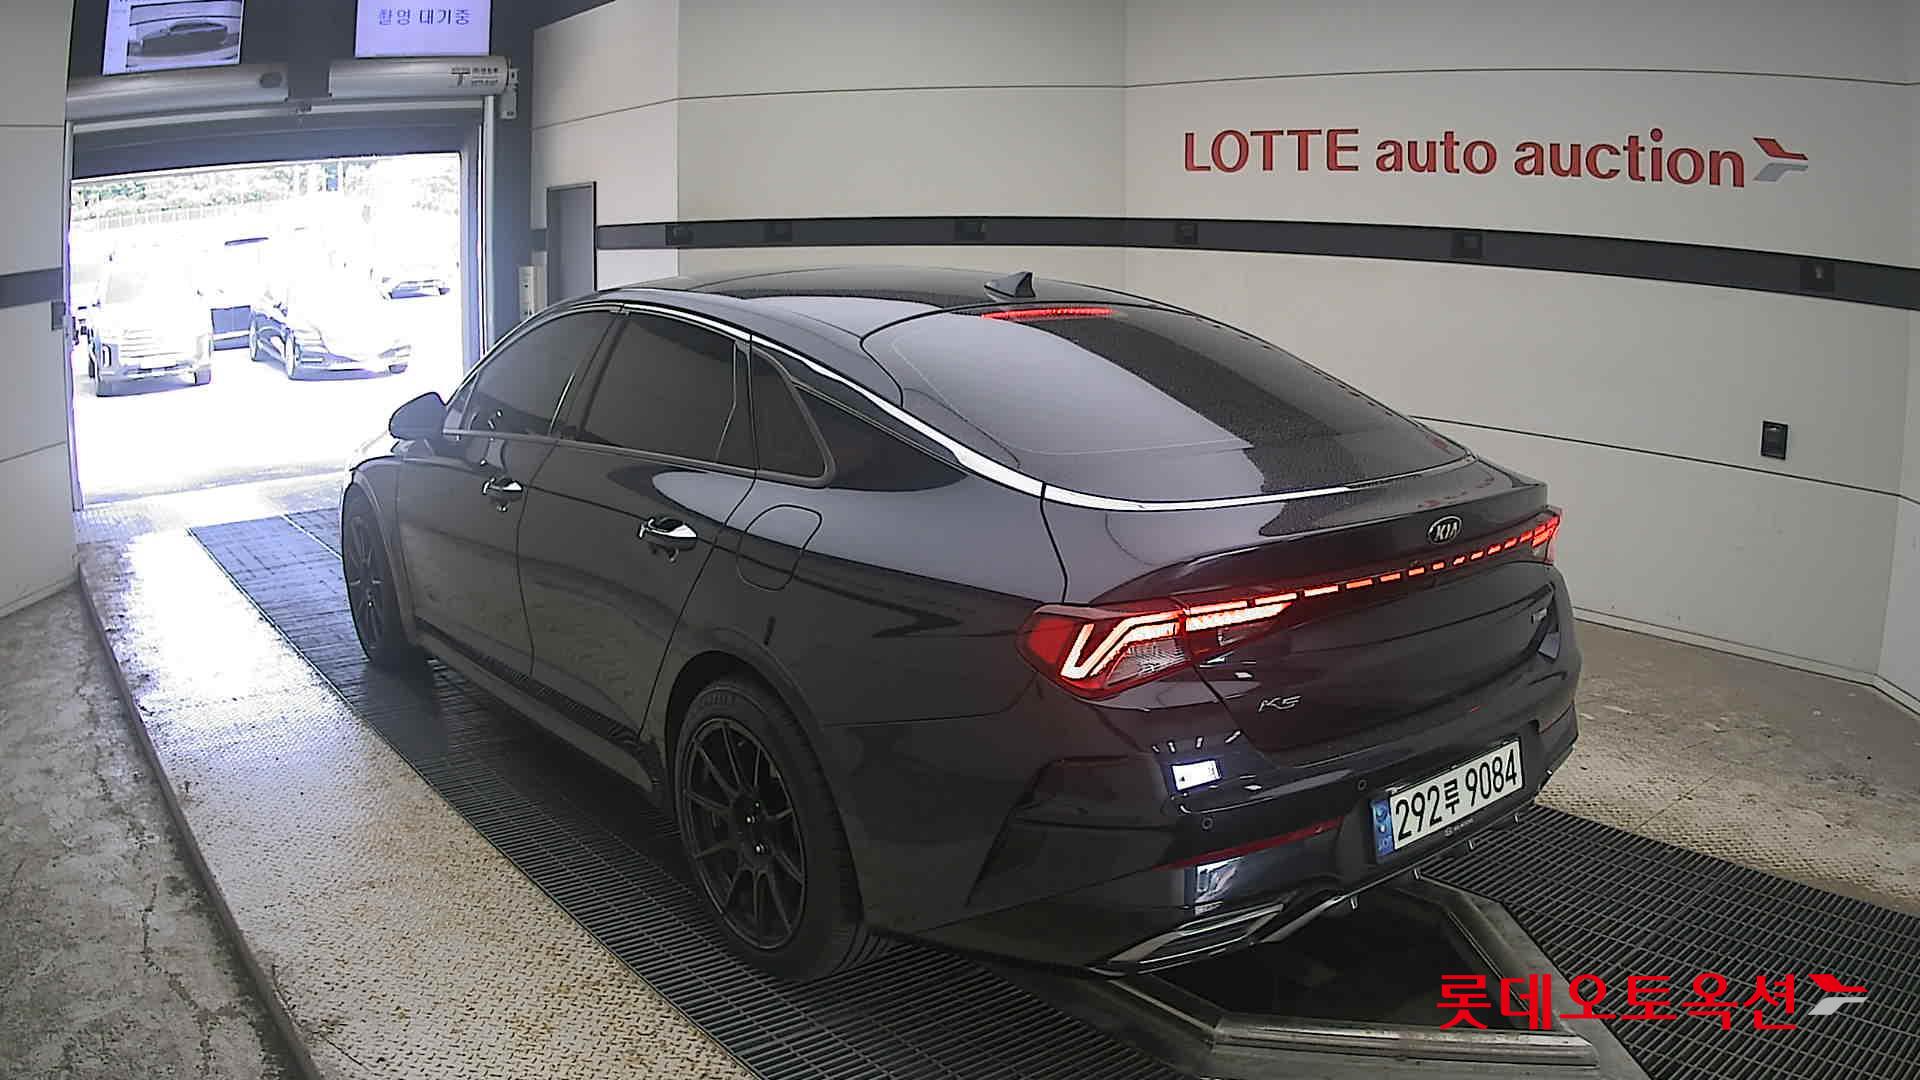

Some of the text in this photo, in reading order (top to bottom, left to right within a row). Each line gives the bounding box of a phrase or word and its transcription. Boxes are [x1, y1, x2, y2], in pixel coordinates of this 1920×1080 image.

[419, 8, 472, 26] 대기중
[1185, 128, 1745, 188] LOTTE auto auction
[1258, 695, 1302, 713] K5
[1395, 748, 1518, 841] 292루 9084
